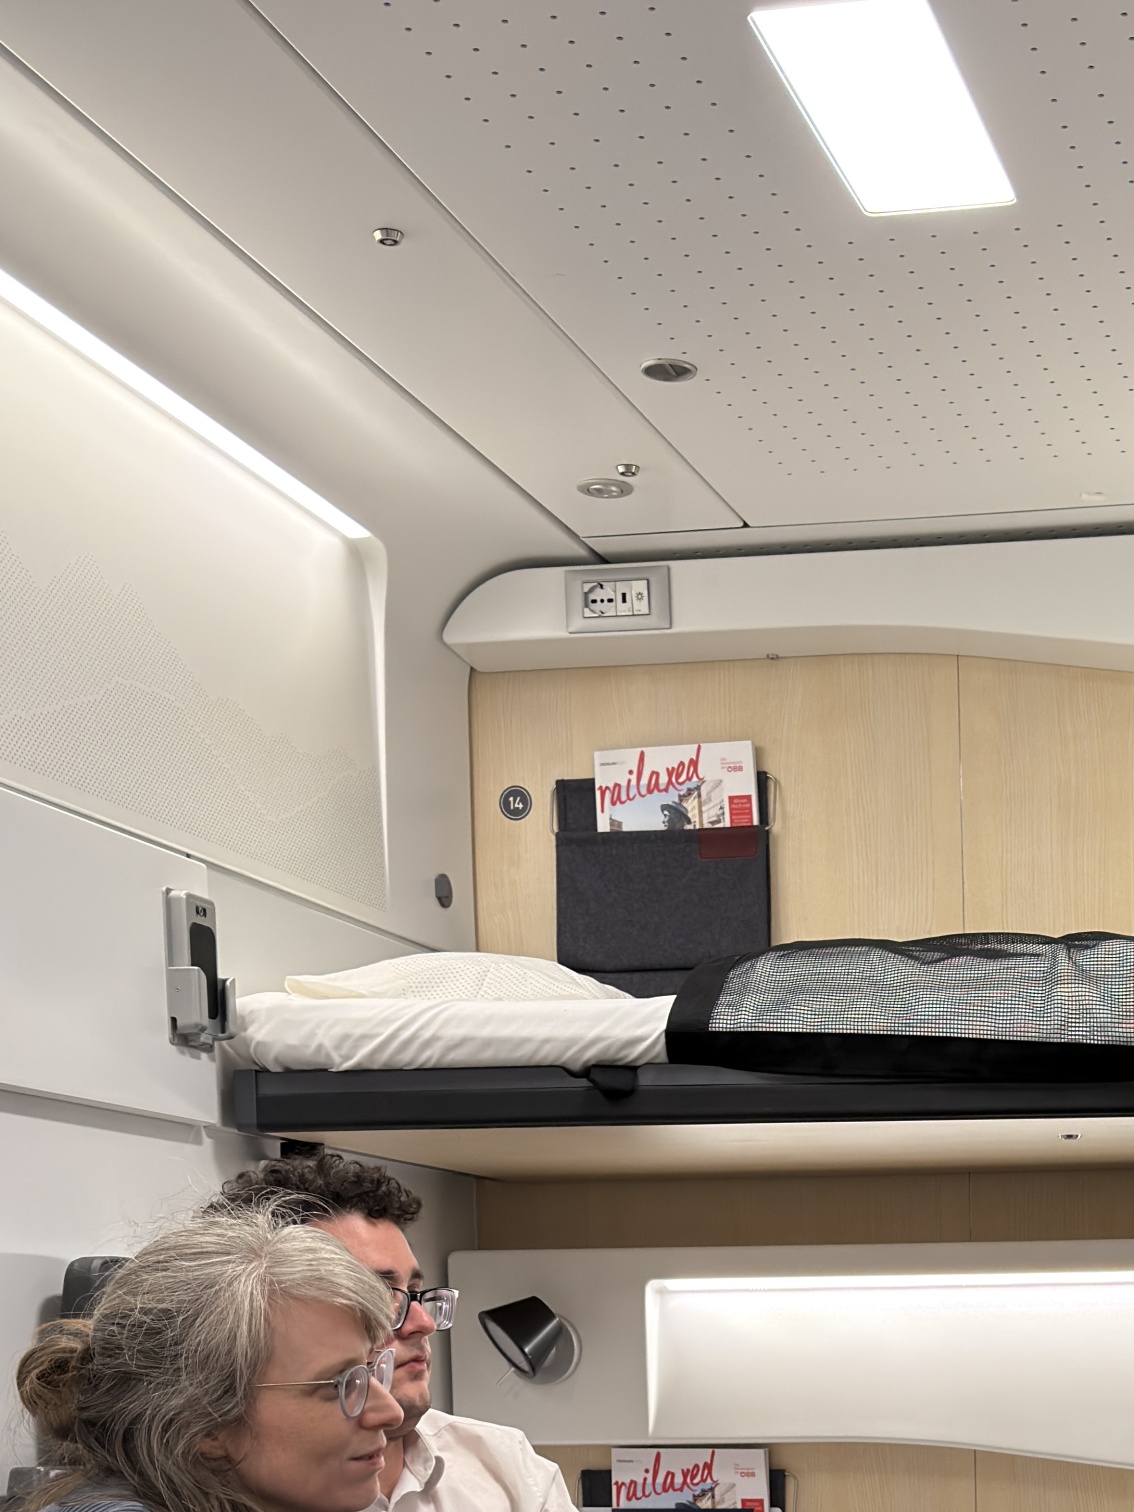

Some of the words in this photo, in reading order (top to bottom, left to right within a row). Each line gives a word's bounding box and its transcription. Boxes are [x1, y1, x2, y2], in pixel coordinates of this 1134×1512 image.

[508, 796, 524, 810] 14
[597, 744, 704, 814] railaxed
[613, 1450, 719, 1507] railaxed
